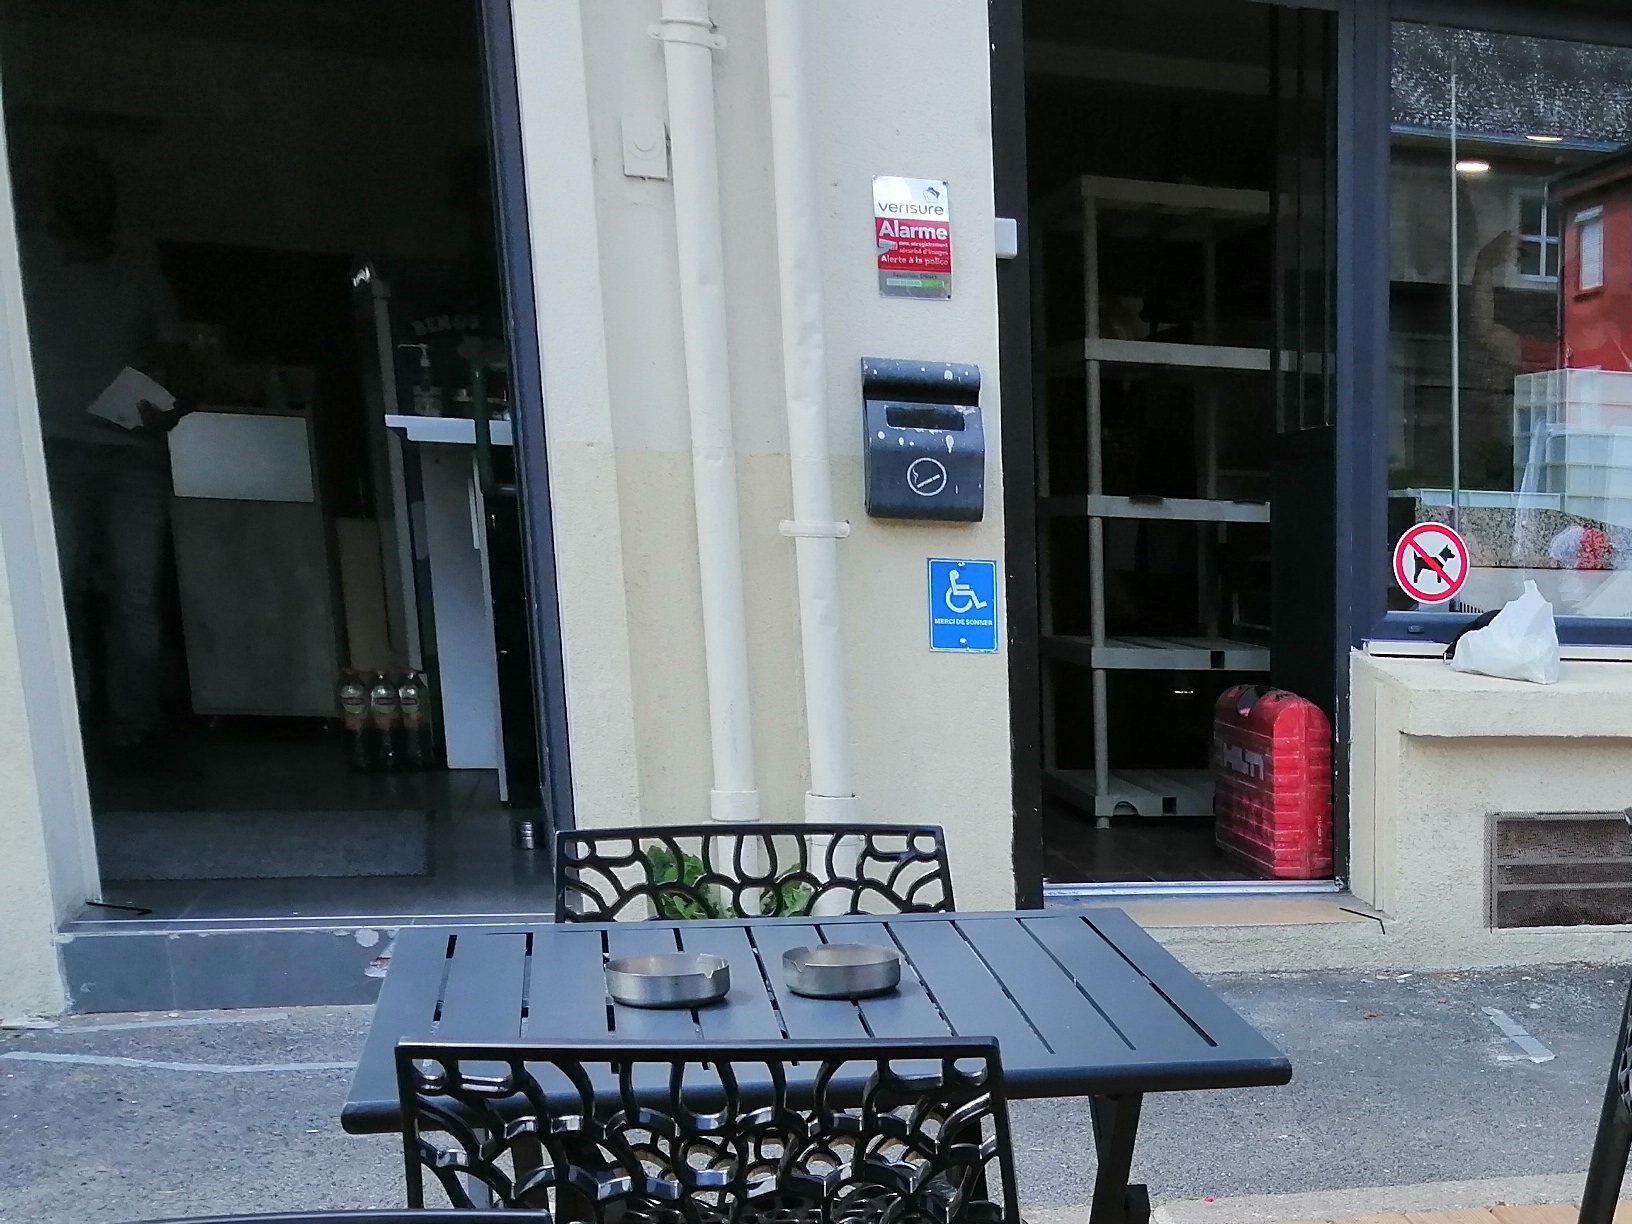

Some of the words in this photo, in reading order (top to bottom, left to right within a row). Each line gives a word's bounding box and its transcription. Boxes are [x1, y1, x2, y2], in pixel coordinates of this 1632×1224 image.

[878, 202, 944, 216] verisure
[879, 220, 948, 240] Alarme
[881, 254, 907, 264] Alerte
[934, 617, 956, 625] MERCI
[956, 618, 966, 626] DE
[966, 618, 993, 626] SONNER
